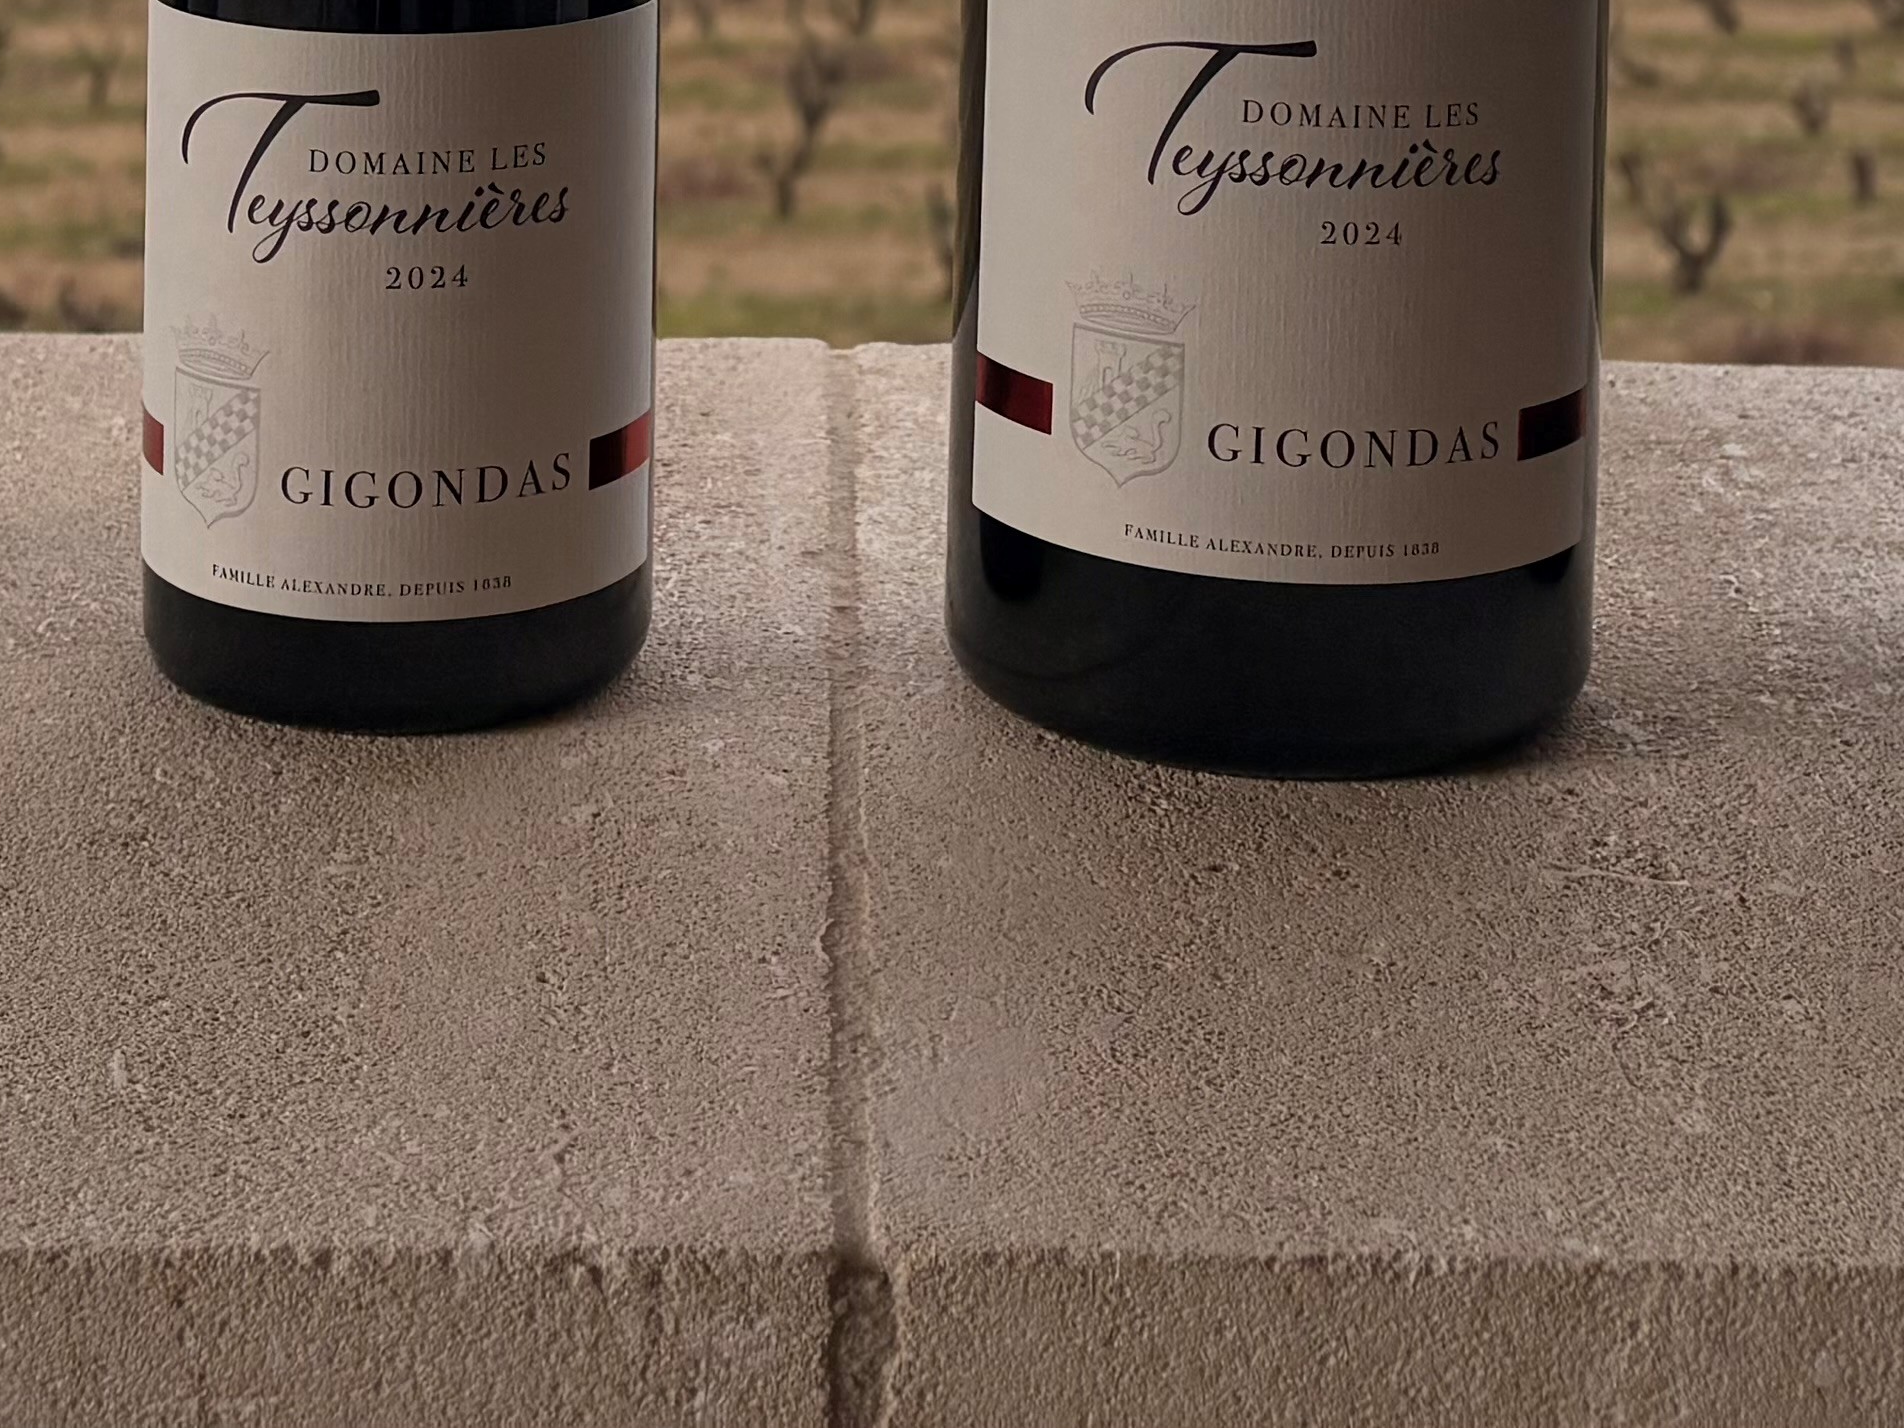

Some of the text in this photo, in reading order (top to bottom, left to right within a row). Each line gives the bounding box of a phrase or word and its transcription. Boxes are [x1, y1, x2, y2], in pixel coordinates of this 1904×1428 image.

[1084, 39, 1502, 216] Teyssonnières
[1241, 97, 1480, 130] DOMAINE LES
[180, 89, 570, 264] Teyssonnières
[308, 142, 547, 176] DOMAINE LES
[1319, 220, 1403, 247] 2024
[384, 264, 469, 291] 2024
[1206, 420, 1500, 470] GIGONDAS
[280, 451, 572, 510] GIGONDAS
[1123, 523, 1200, 550] FAMILLE
[1206, 537, 1323, 561] ALEXANDRE,
[1330, 543, 1396, 559] DEPUIS
[211, 563, 276, 589] FAMILLE
[399, 577, 466, 597] DEPUIS
